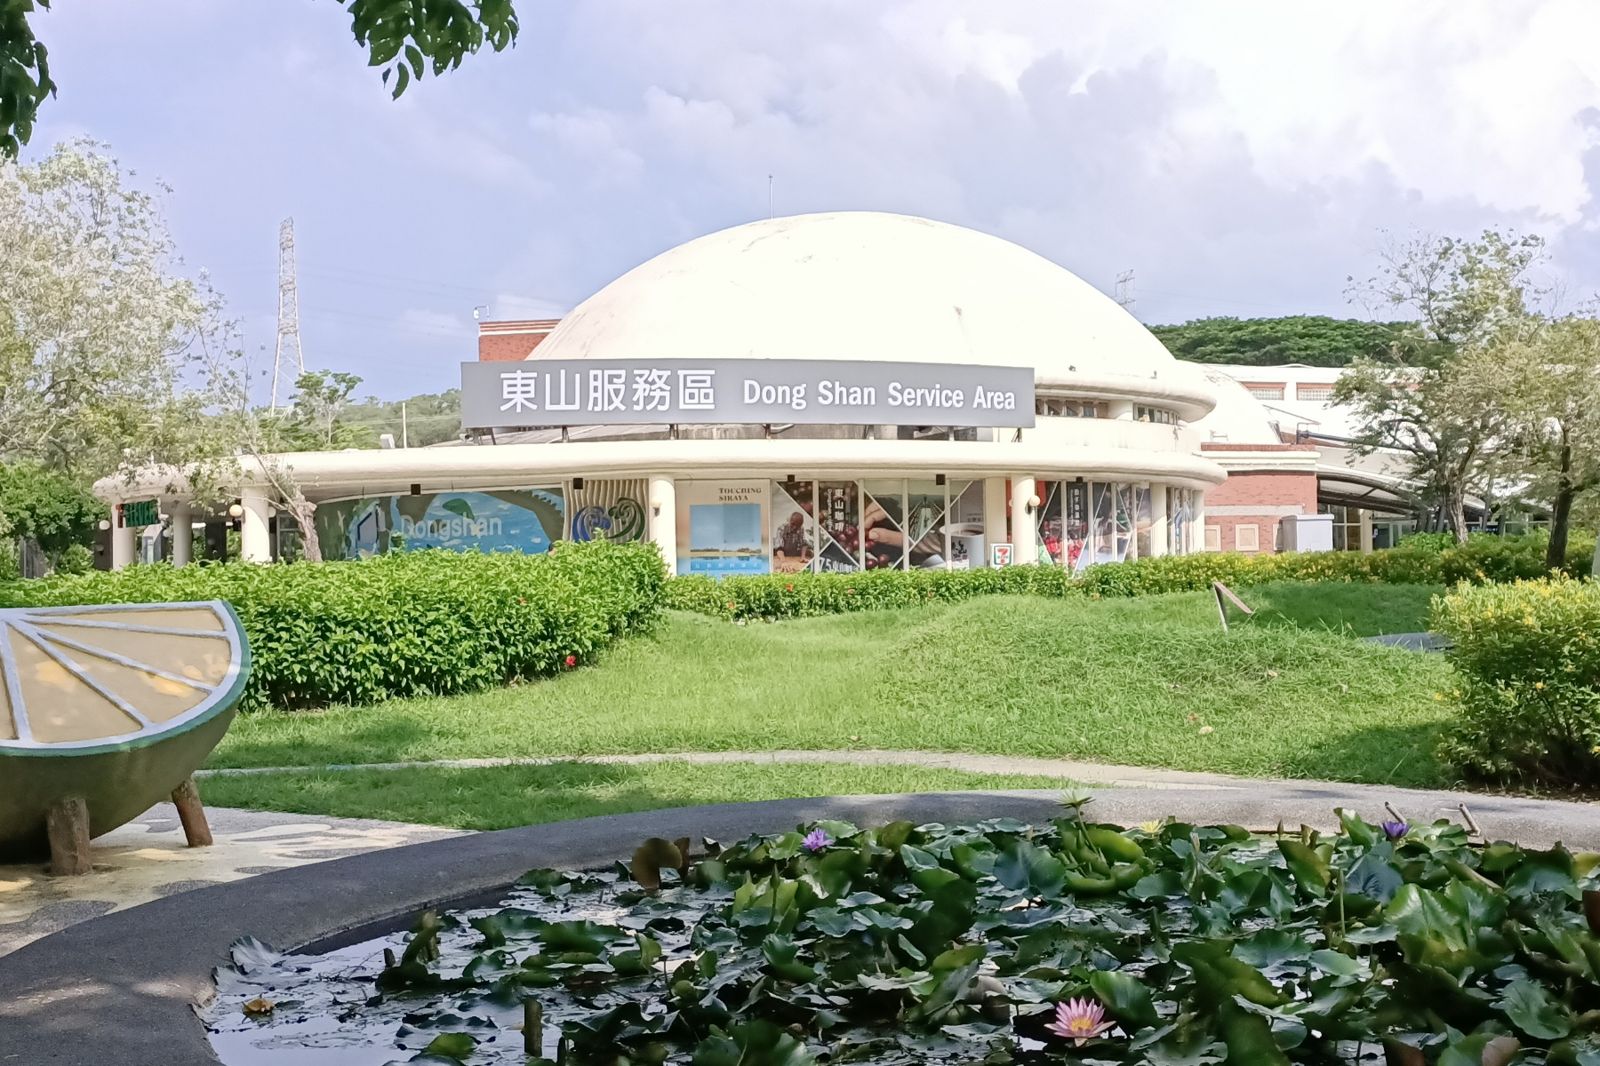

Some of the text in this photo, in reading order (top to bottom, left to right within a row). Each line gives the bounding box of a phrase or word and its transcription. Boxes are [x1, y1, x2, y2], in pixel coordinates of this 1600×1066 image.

[500, 369, 716, 412] 東山服務區
[743, 379, 1015, 410] Dong Shan Service Area
[401, 512, 502, 541] Dongshan
